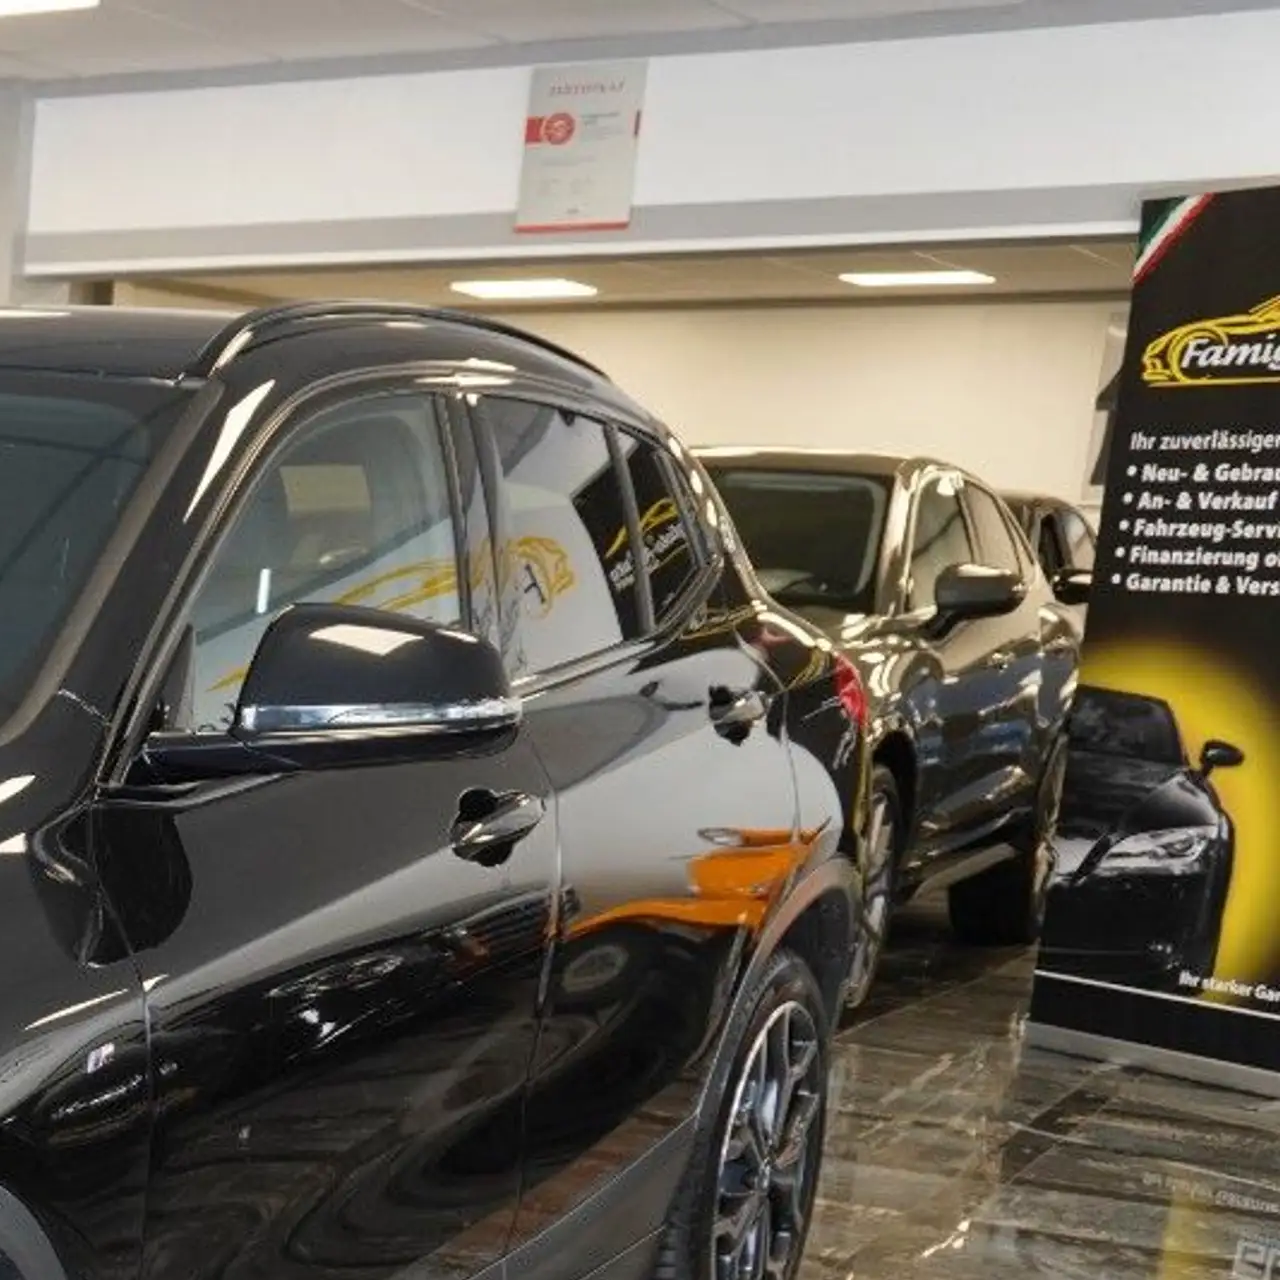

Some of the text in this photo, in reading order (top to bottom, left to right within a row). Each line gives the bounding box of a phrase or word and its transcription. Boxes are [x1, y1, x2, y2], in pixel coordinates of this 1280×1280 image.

[1130, 431, 1156, 450] Ihr
[1141, 463, 1189, 482] Neu-
[1192, 463, 1209, 482] &
[1136, 490, 1279, 510] An- & Verkauf
[1129, 545, 1260, 572] Finanzierung
[1126, 573, 1212, 592] Garantie
[1215, 575, 1231, 594] &
[1179, 969, 1200, 987] Ihr
[1201, 978, 1254, 997] starker
